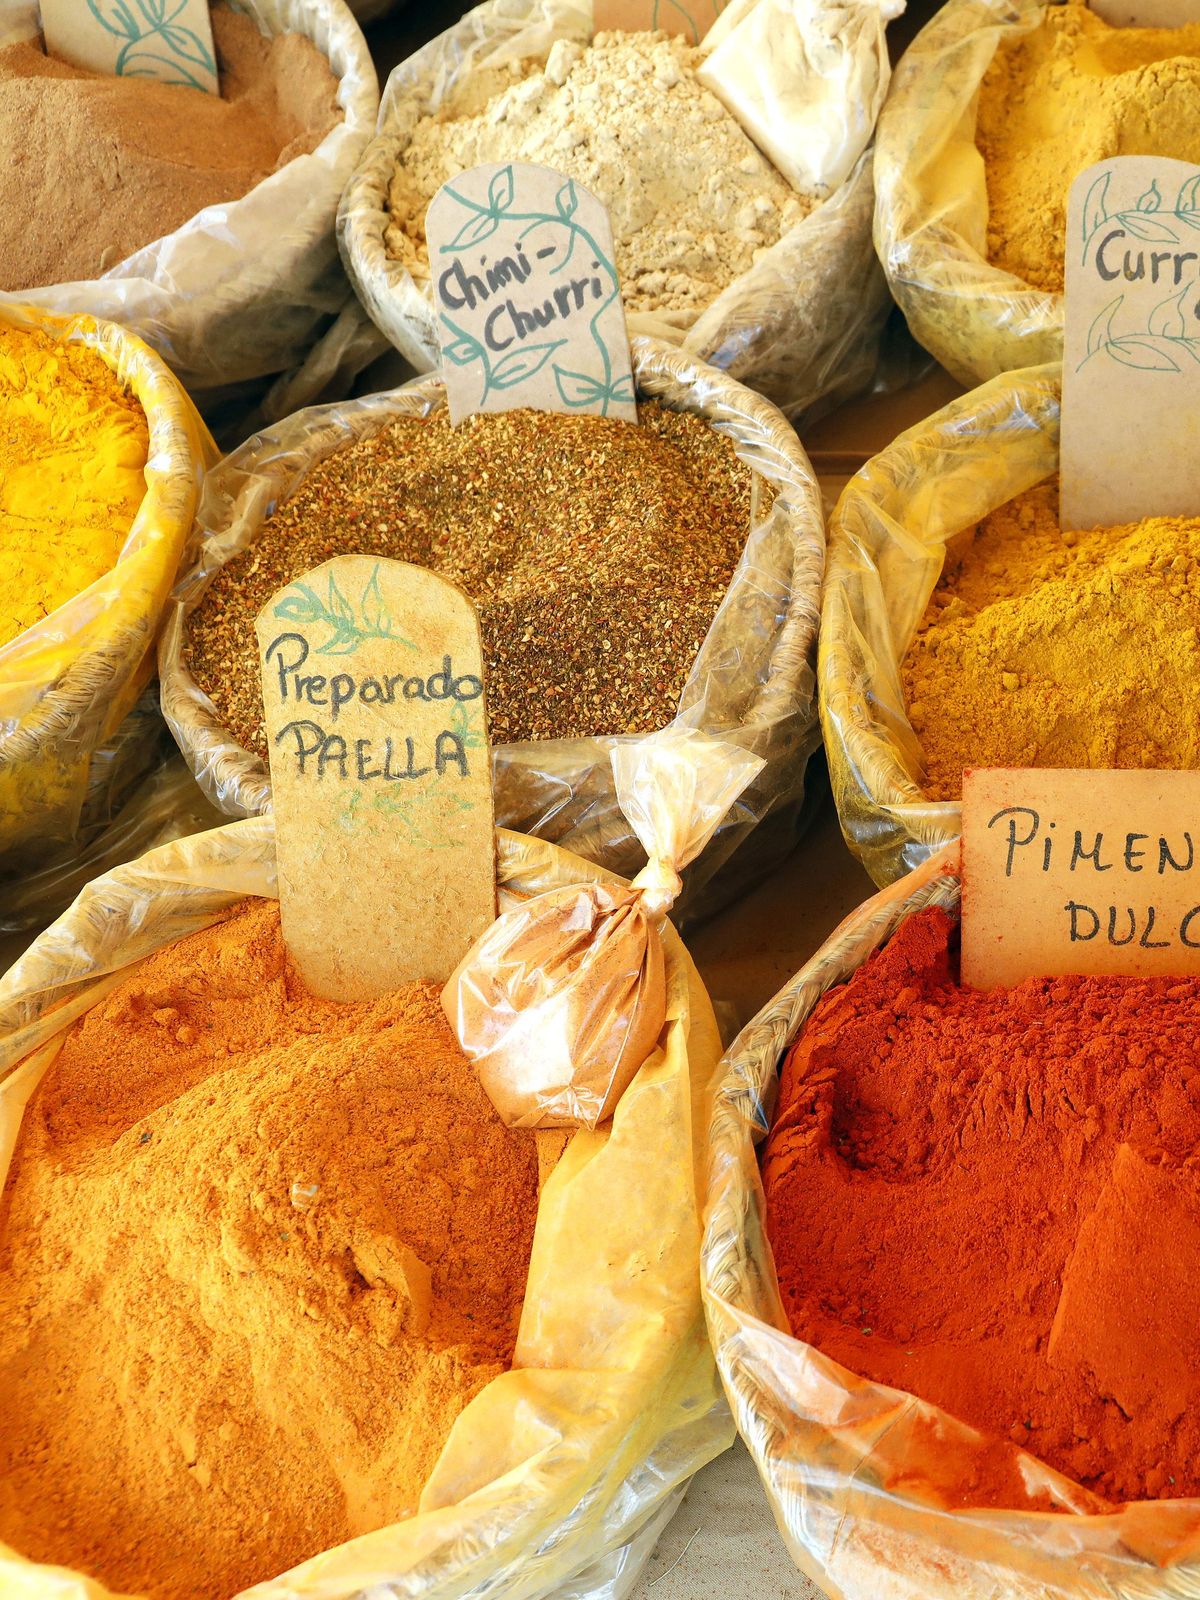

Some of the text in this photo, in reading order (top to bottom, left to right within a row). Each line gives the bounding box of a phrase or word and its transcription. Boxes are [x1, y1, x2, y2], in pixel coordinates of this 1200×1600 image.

[438, 242, 556, 311] Chimi-
[484, 261, 602, 351] Churri
[265, 632, 484, 722] Preparado
[275, 719, 471, 781] PAELLA
